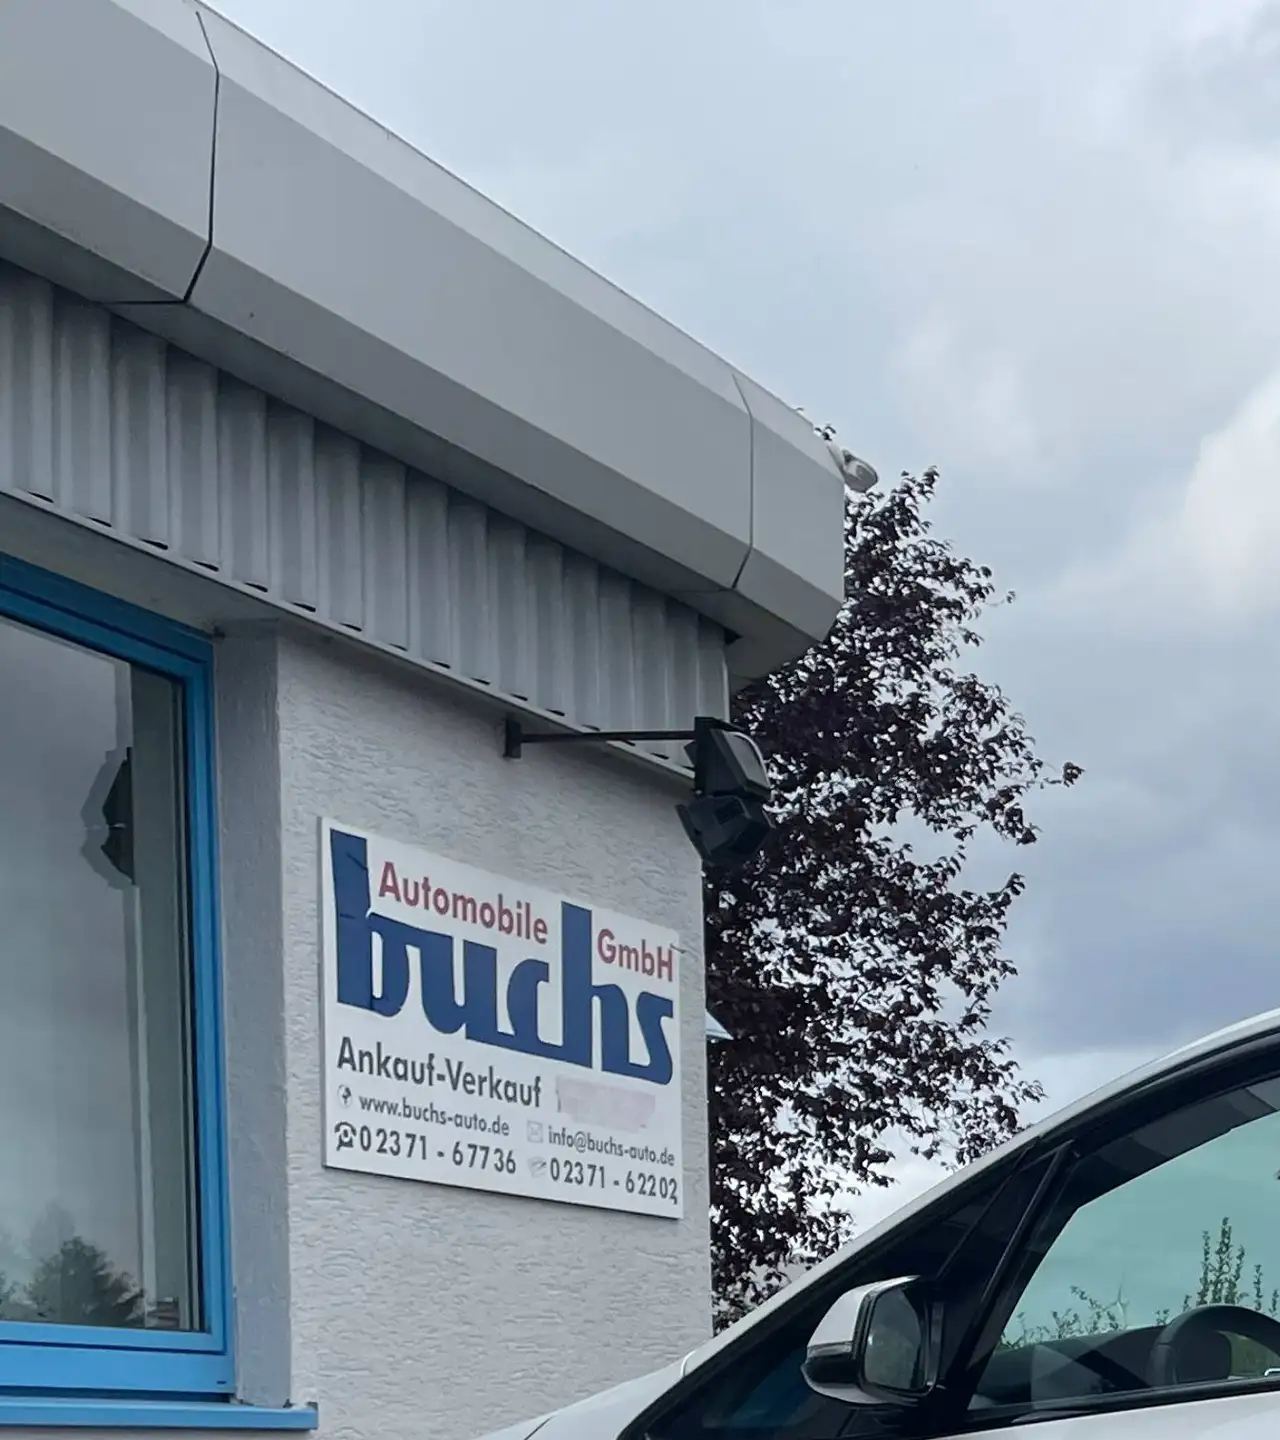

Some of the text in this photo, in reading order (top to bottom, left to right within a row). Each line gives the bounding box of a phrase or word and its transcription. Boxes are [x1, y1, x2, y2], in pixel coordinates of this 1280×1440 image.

[378, 861, 673, 982] Automobile GmbH
[330, 828, 674, 1086] buchs
[337, 1036, 542, 1108] Ankauf-Verkauf
[358, 1094, 510, 1136] www.buchs-auto.de
[359, 1125, 428, 1160] 02371
[452, 1140, 517, 1174] 67736
[548, 1125, 675, 1166] info@buchs-auto.de
[550, 1157, 606, 1189] 02371
[625, 1170, 678, 1204] 62202
